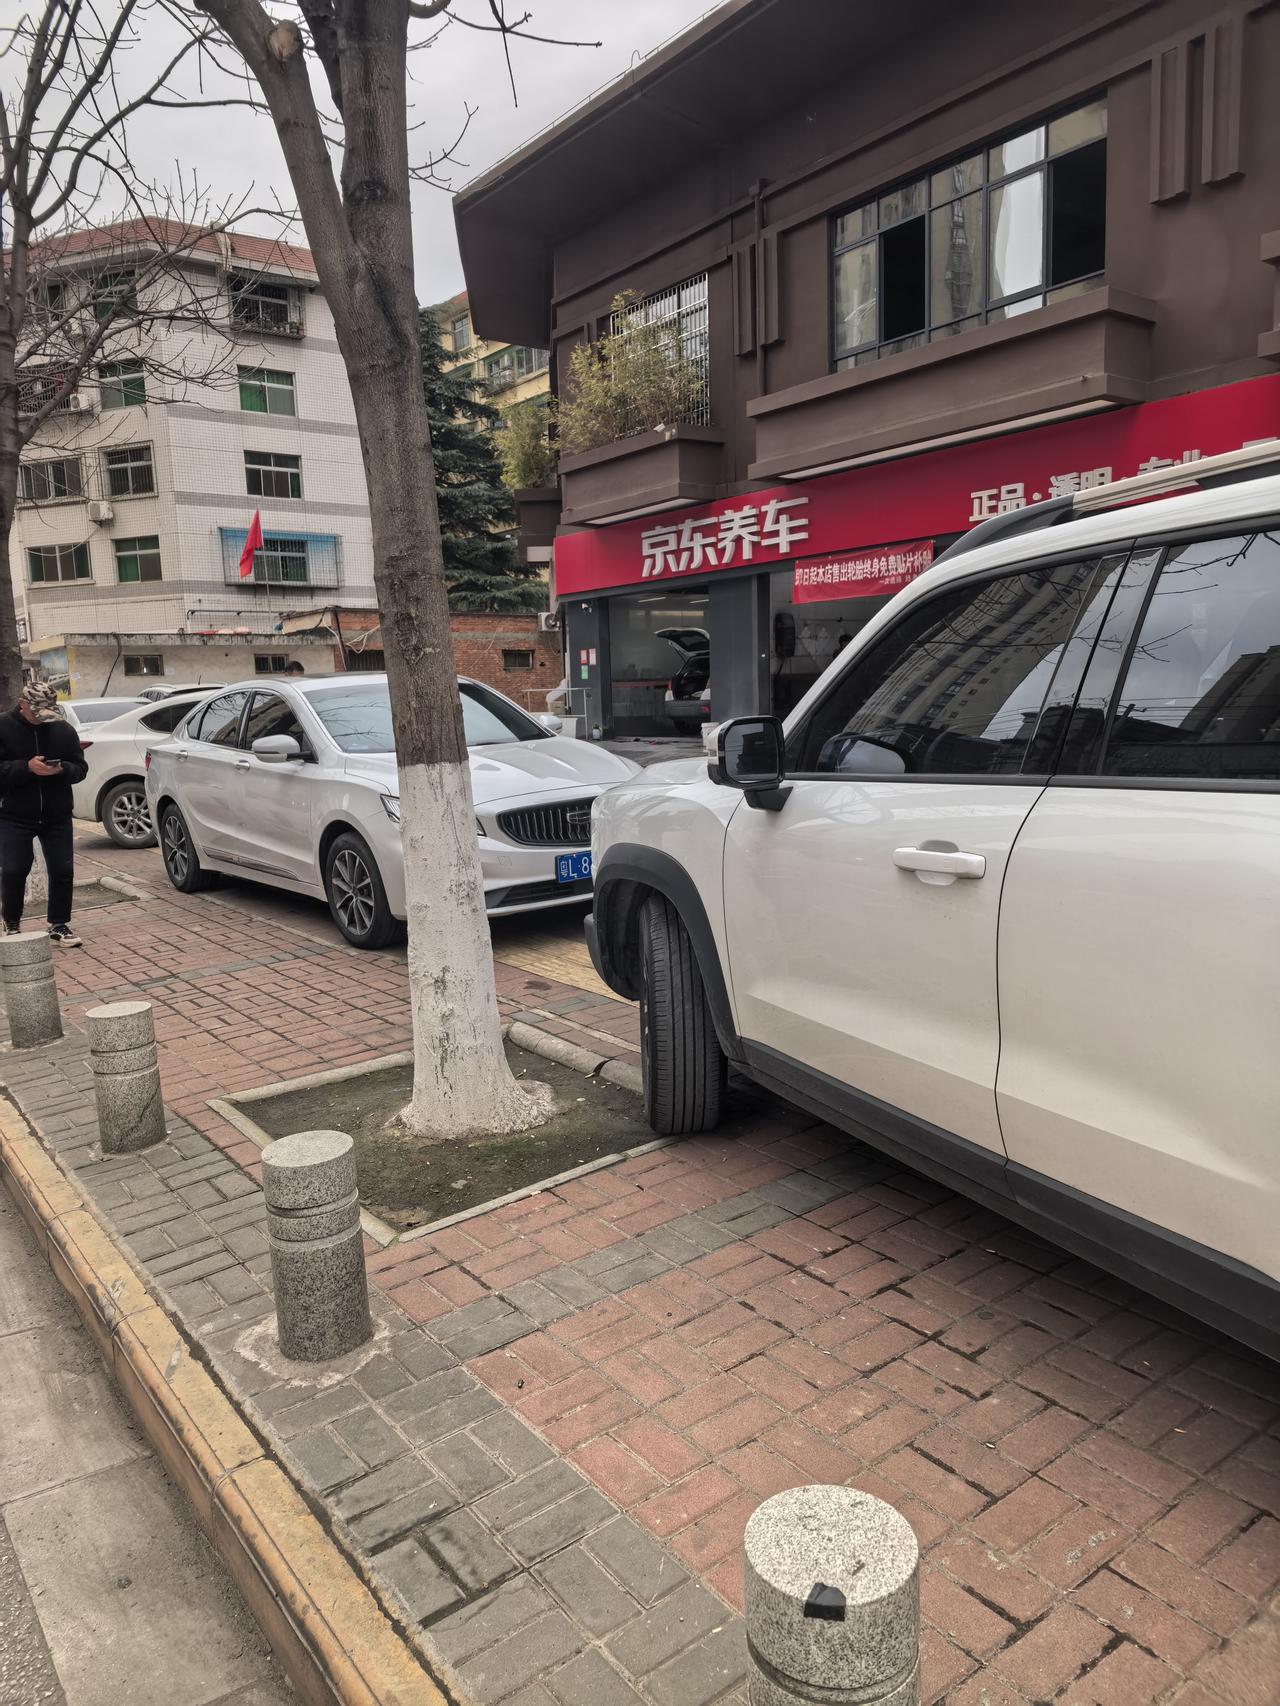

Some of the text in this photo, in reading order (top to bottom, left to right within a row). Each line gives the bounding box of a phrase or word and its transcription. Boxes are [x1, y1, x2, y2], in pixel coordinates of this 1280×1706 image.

[641, 497, 808, 577] 京东养车
[560, 857, 592, 878] 粤L·8
